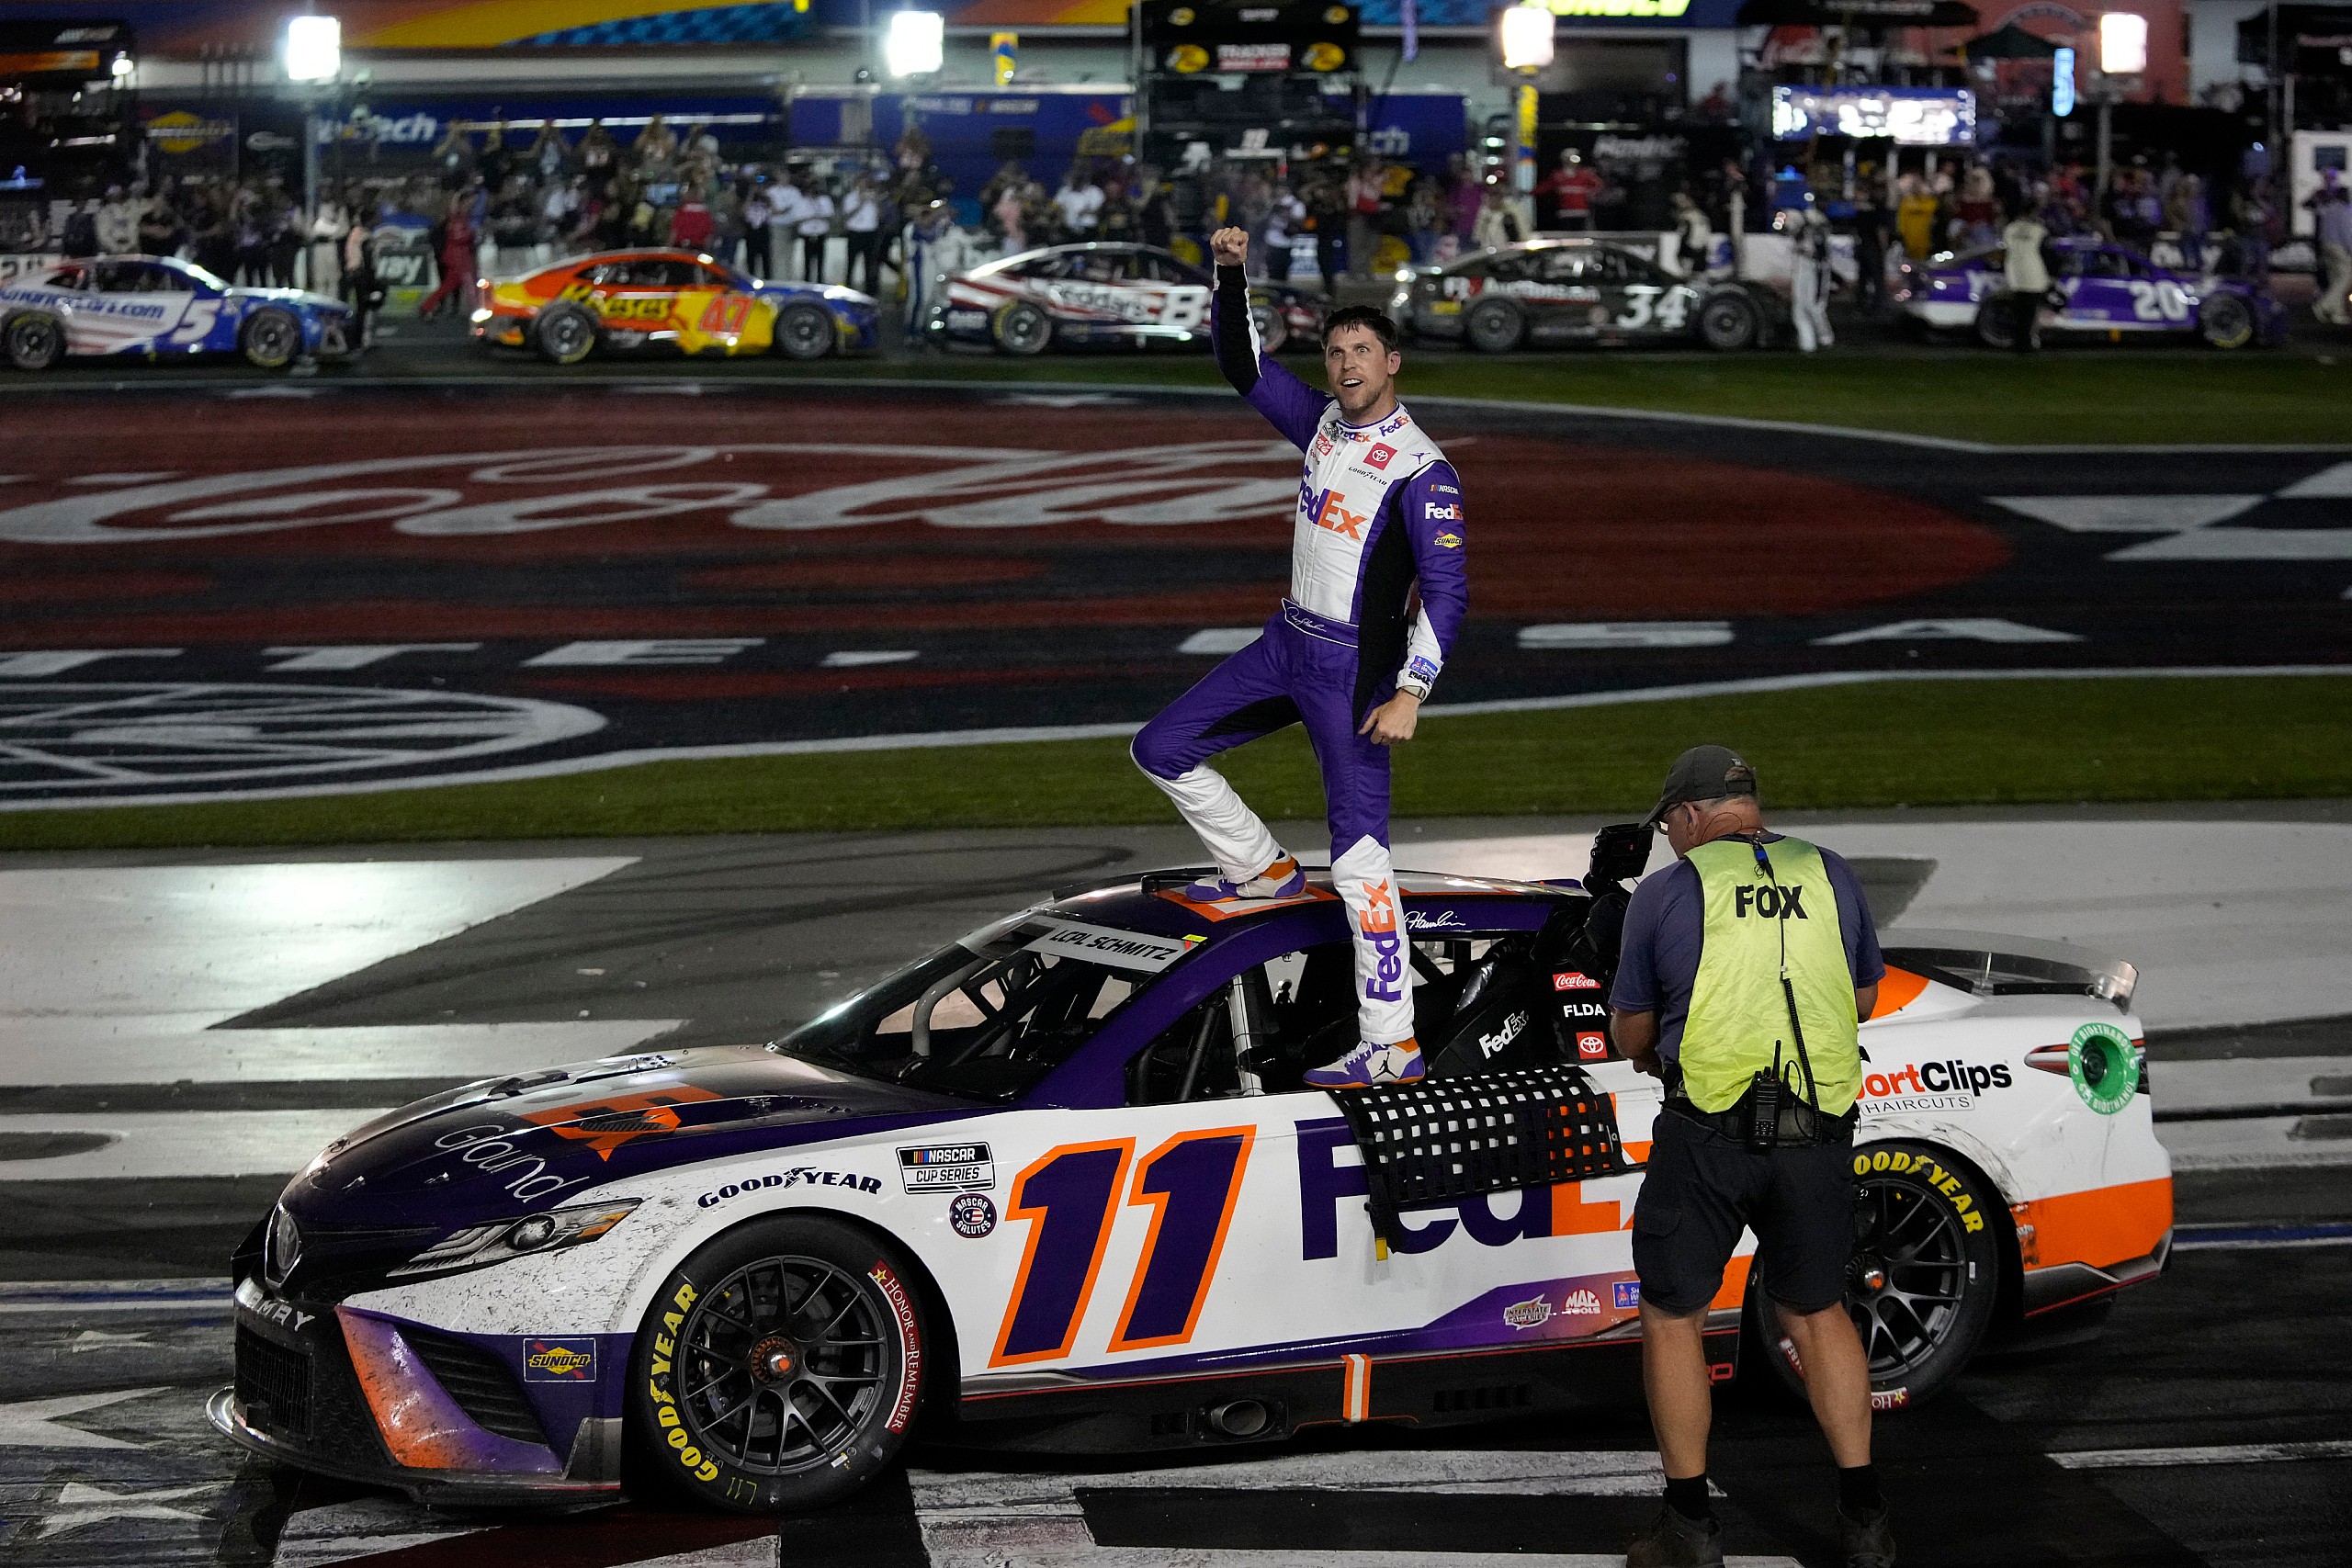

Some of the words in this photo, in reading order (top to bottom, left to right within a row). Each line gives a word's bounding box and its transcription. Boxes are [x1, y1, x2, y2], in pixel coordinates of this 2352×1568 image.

[698, 293, 755, 333] 47
[1159, 286, 1209, 330] 8
[1617, 285, 1690, 329] 34
[2129, 280, 2190, 321] 20
[171, 299, 222, 343] 5
[1378, 415, 1411, 437] FedEx
[1348, 466, 1388, 487] GOODYEAR
[1425, 502, 1464, 521] FedE
[1735, 884, 1809, 919] FOX
[1048, 929, 1092, 946] LCPL
[1087, 936, 1179, 962] SCHMITZ
[1359, 876, 1402, 1003] FedEx
[1563, 1003, 1606, 1018] FLDA
[1478, 1010, 1528, 1060] FedEx
[1864, 1096, 1971, 1114] HAIRCUTS
[927, 1147, 976, 1164] NASCAR
[697, 1167, 883, 1209] GOODYEAR
[916, 1169, 938, 1183] CUP
[939, 1167, 980, 1182] SERIES
[955, 1197, 989, 1212] NASCAR
[1852, 1150, 1985, 1234] OODYEAR
[956, 1219, 991, 1235] SALUTES
[987, 1123, 1258, 1370] 11
[884, 1278, 914, 1333] HONOR
[1505, 1305, 1549, 1316] INTERSTATE
[1566, 1289, 1600, 1308] MAC
[1566, 1306, 1601, 1314] TOOLS
[907, 1332, 916, 1351] AND
[529, 1354, 591, 1368] SUNOCO
[649, 1282, 718, 1482] GOODYEAR
[891, 1348, 920, 1429] REMEMBER
